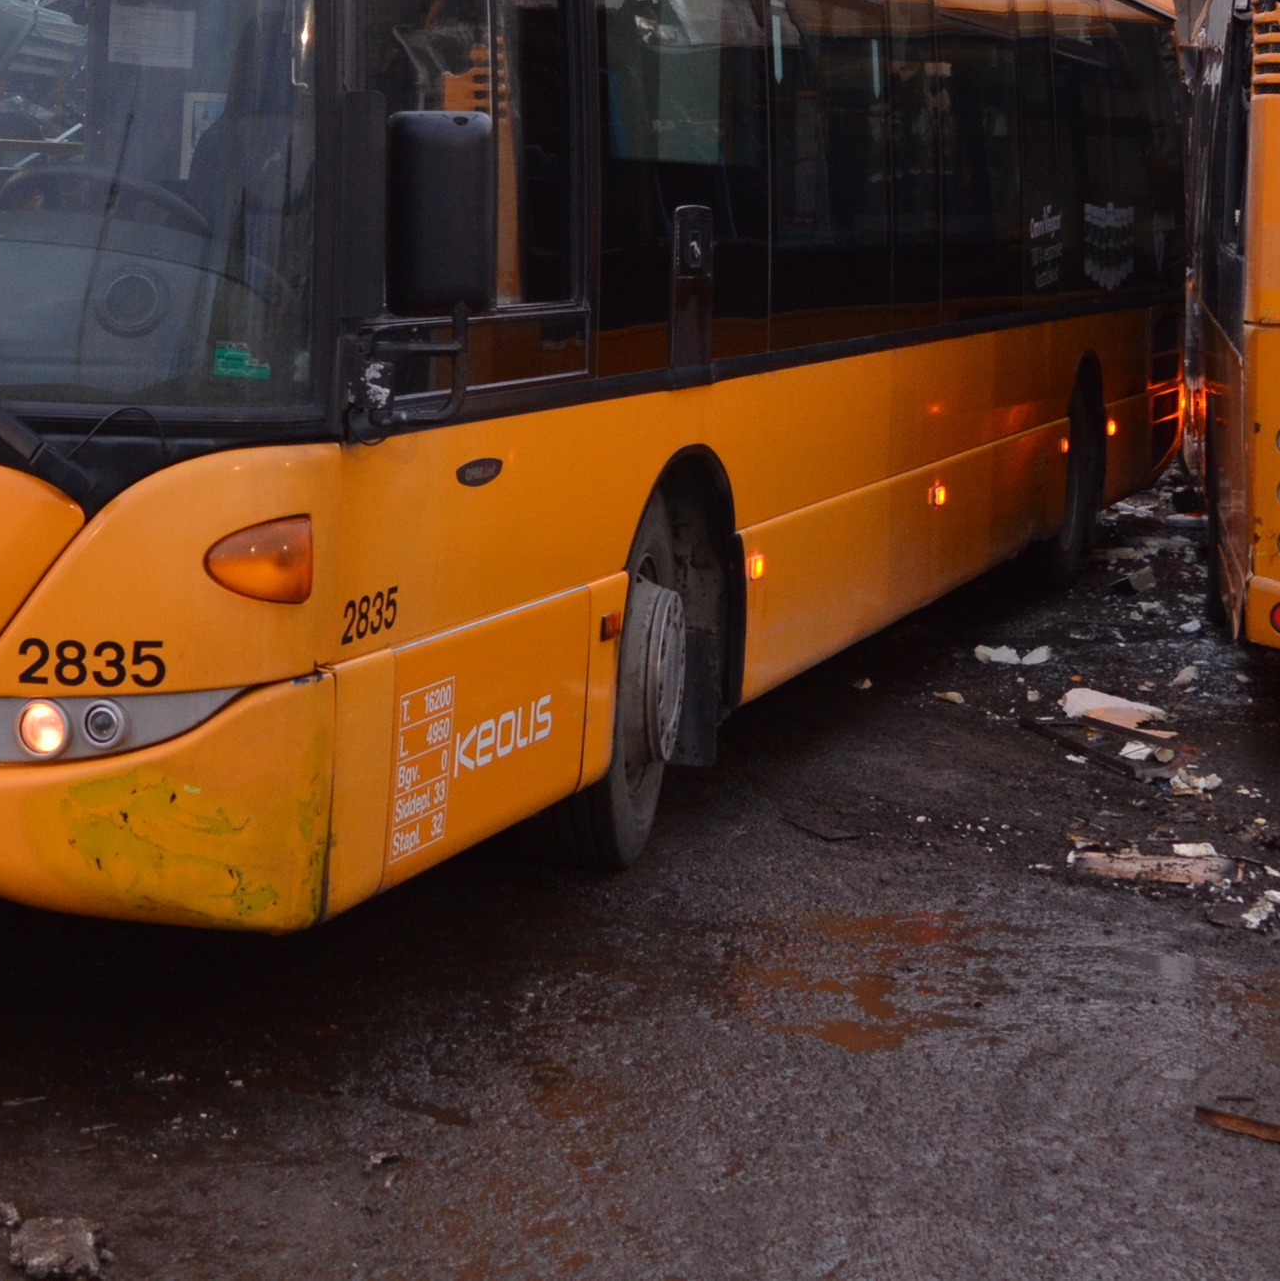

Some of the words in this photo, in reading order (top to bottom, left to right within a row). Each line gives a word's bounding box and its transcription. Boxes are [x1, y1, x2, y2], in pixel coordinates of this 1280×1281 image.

[341, 586, 399, 646] 2835
[18, 638, 166, 688] 2835
[424, 684, 452, 714] 16200
[426, 717, 450, 745] 4950
[397, 765, 420, 791] Bgv.
[441, 749, 448, 771] 0
[433, 779, 446, 804] 33
[430, 812, 444, 837] 32
